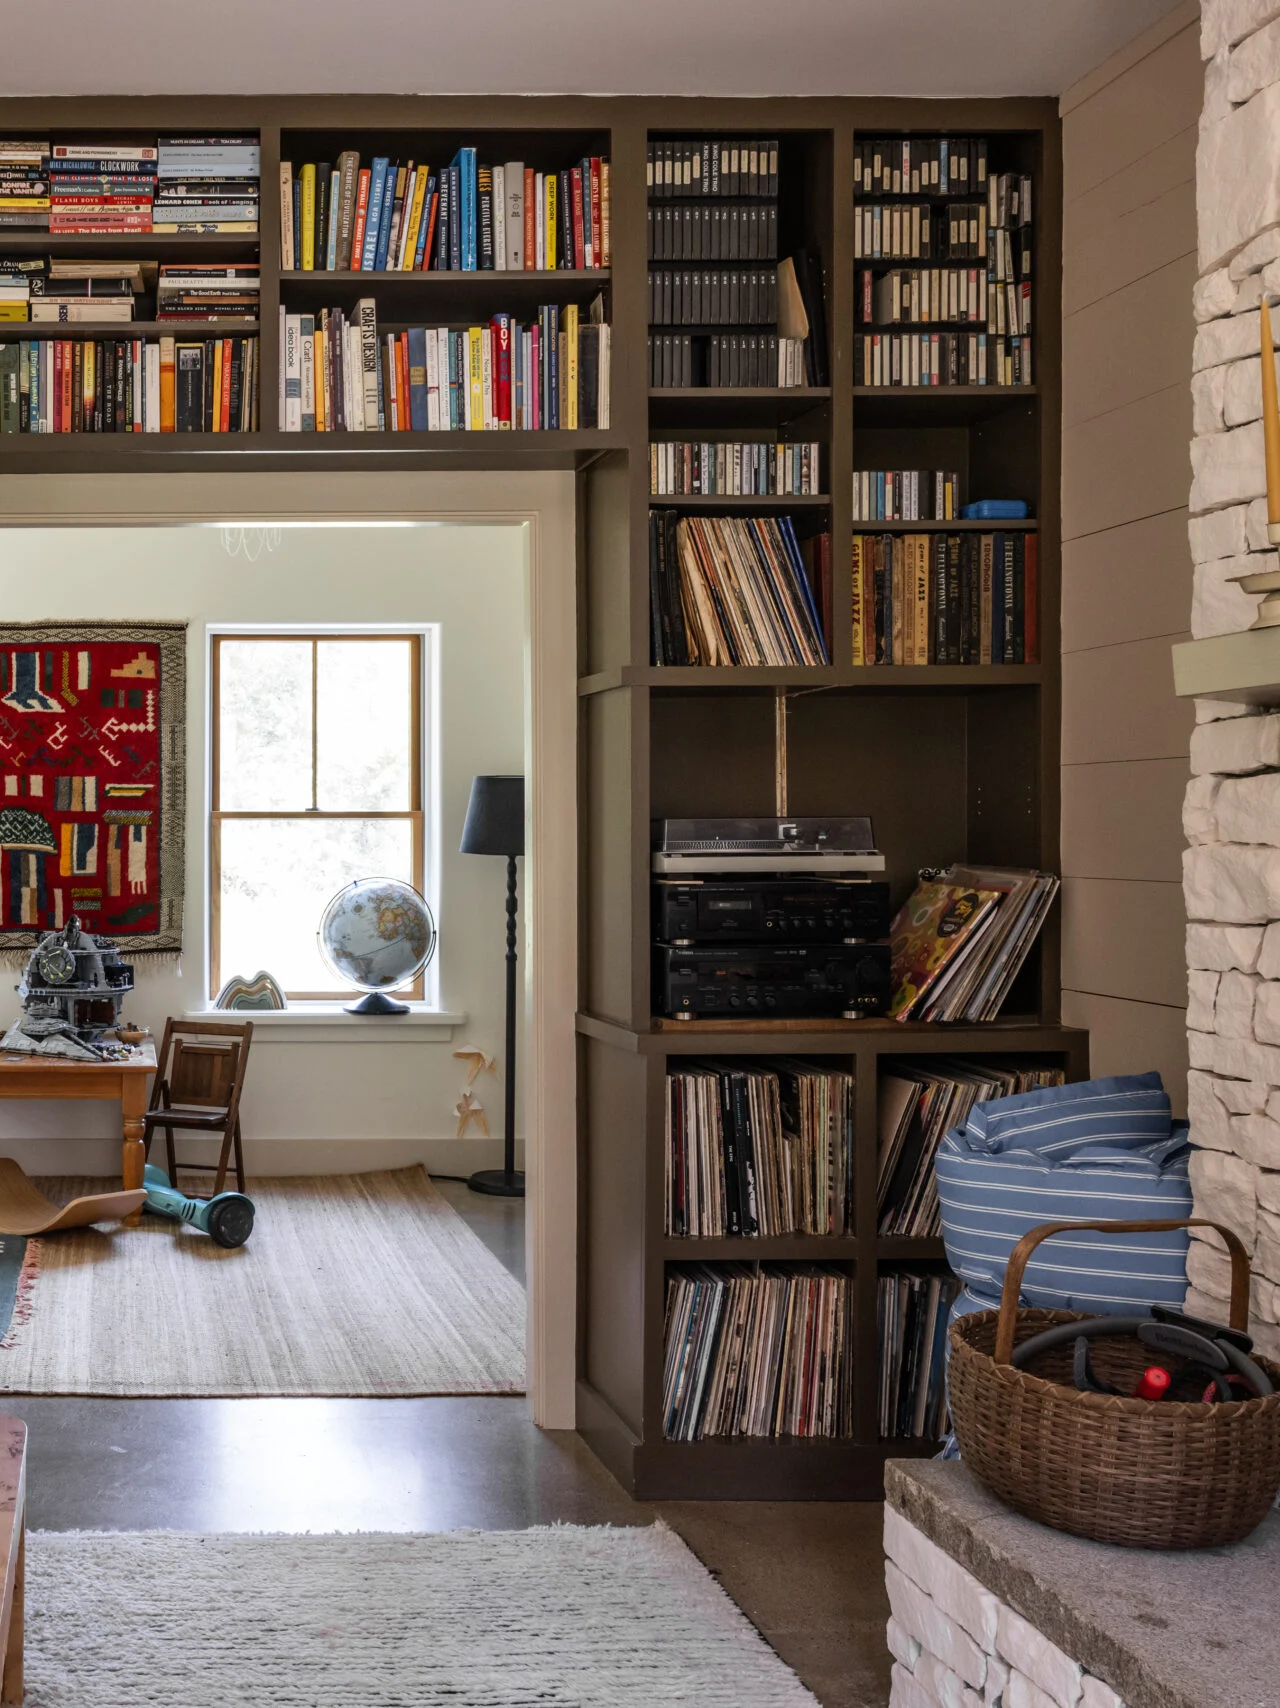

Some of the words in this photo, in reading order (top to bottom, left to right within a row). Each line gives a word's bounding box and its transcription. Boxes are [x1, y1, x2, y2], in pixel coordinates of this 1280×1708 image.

[100, 161, 140, 172] CLOCKWORK
[344, 168, 353, 190] FABRIC
[478, 168, 492, 192] JAMES
[359, 175, 368, 206] MONEYBALL
[440, 184, 448, 221] REVENANT
[341, 199, 351, 238] CIVILIZATION
[482, 196, 491, 225] PERCIVAL
[355, 218, 364, 241] MICHAEL
[482, 227, 491, 255] EVERETT
[354, 242, 362, 259] LEWIS
[287, 326, 295, 345] idea
[361, 307, 375, 340] CRAFTS
[500, 317, 508, 350] BOY
[287, 346, 295, 368] book
[362, 342, 376, 373] DESIGN
[851, 543, 860, 575] GEMS
[937, 553, 946, 609] ELLINGTONIA
[1004, 551, 1013, 608] ELLINGTONIA
[851, 591, 860, 625] JAZZ
